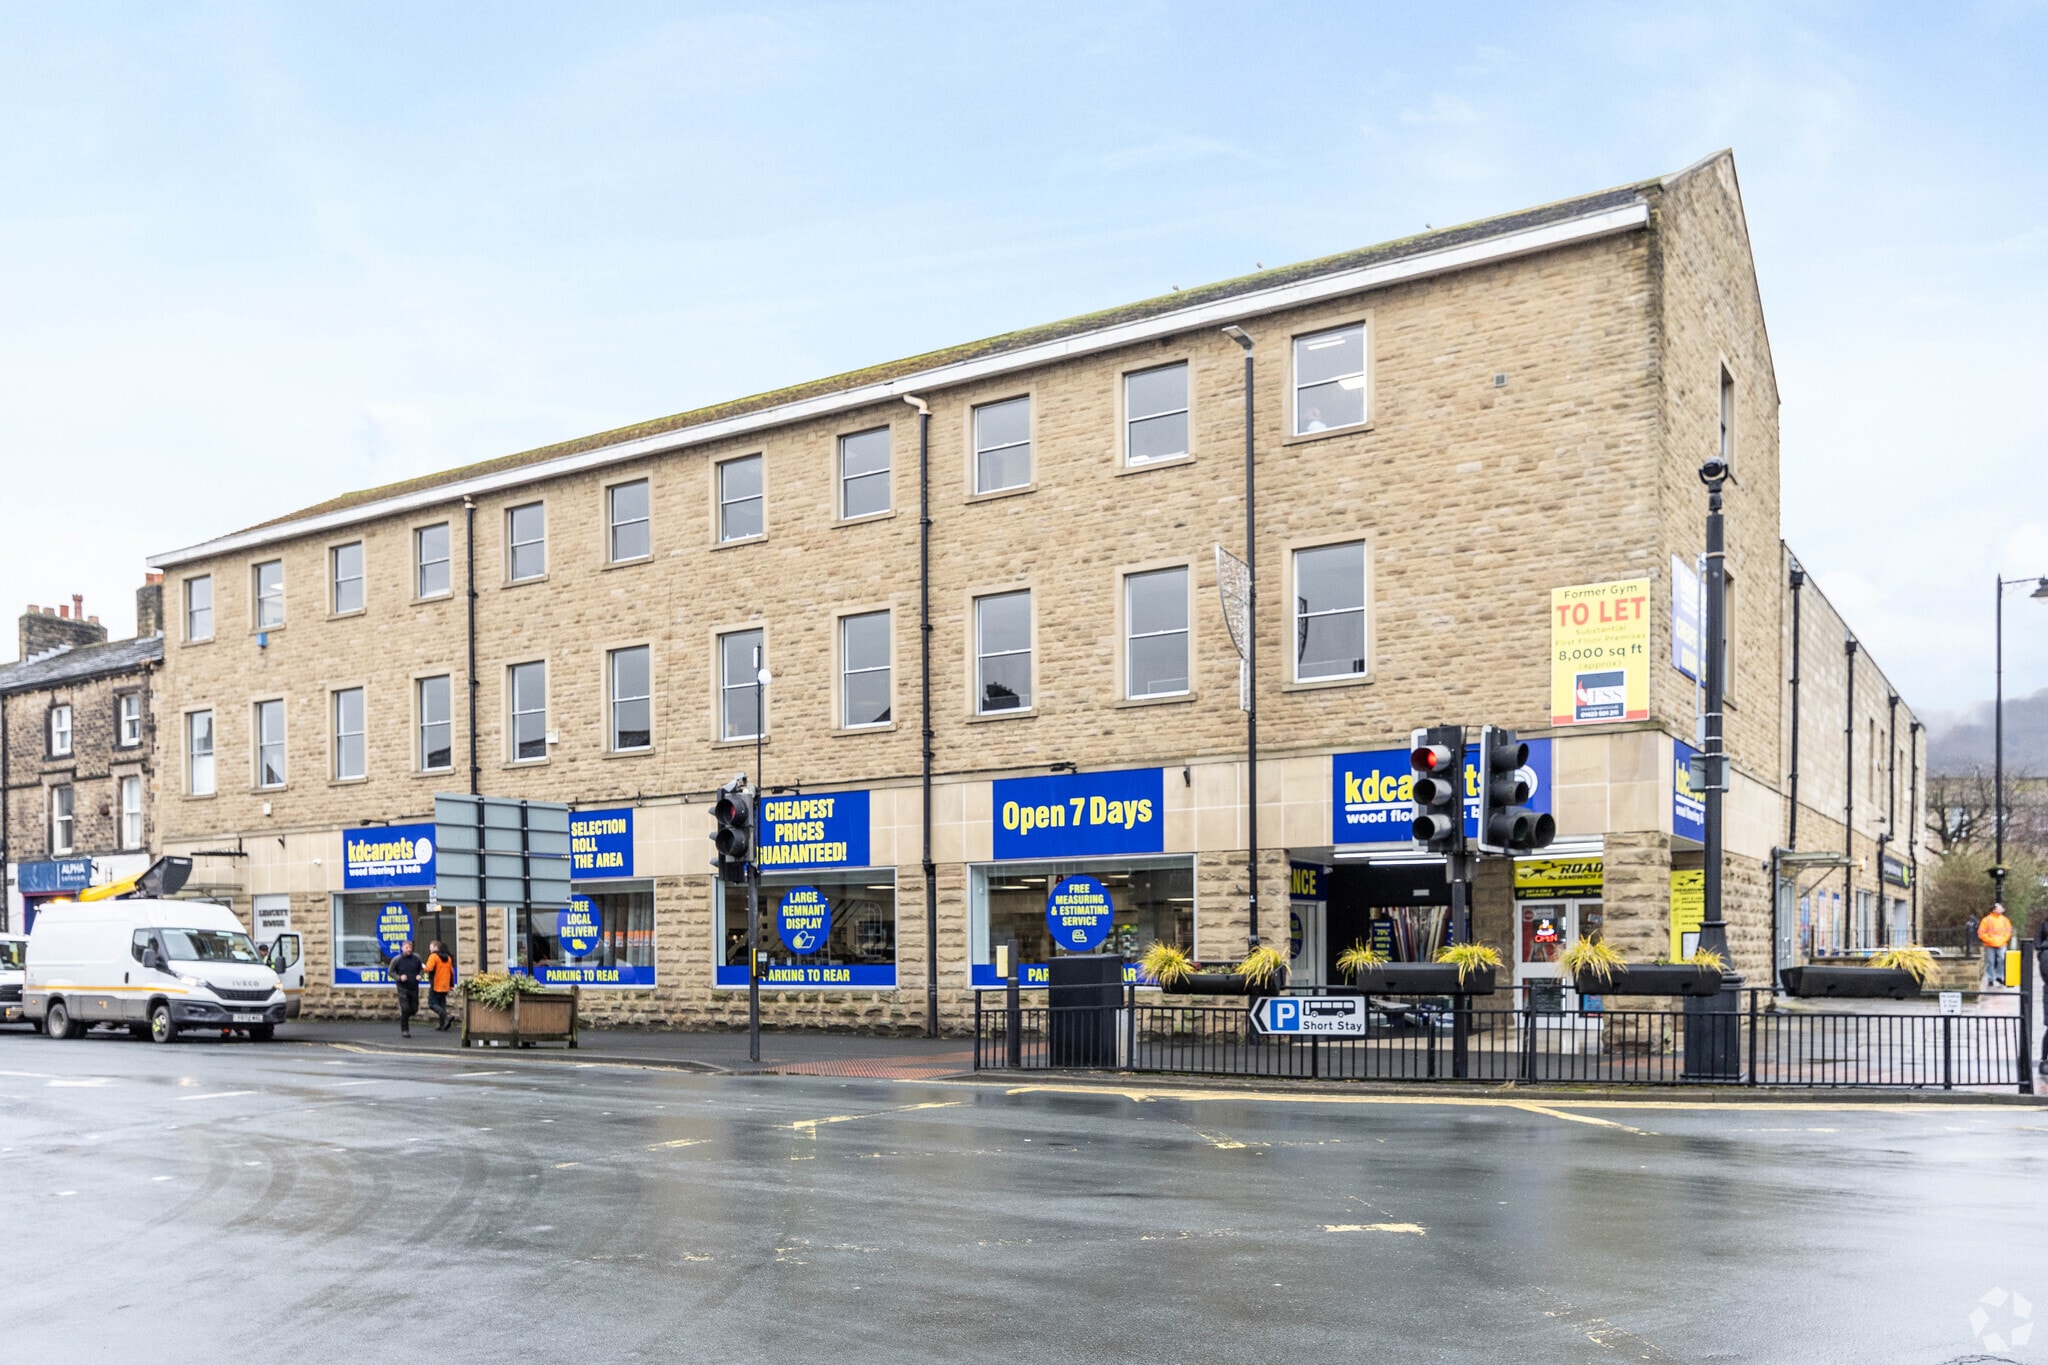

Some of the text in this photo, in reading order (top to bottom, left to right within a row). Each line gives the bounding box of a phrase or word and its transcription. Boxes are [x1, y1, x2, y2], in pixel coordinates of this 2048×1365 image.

[1564, 584, 1637, 600] Former Gym
[1556, 596, 1646, 627] TO LET
[1576, 625, 1626, 635] Substantial
[1559, 643, 1643, 661] 8,000 sq ft
[765, 799, 835, 822] CHEAPEST
[1002, 796, 1152, 835] Open 7 Days
[1346, 809, 1413, 824] wood flo
[571, 818, 626, 837] SELECTION
[775, 821, 825, 843] PRICES
[348, 837, 414, 866] kdcarpets
[572, 837, 598, 853] ROLL
[574, 852, 624, 869] THE AREA
[61, 863, 85, 875] ALPHA
[349, 867, 368, 877] wood
[369, 865, 395, 877] flooring
[403, 864, 421, 874] beds
[1069, 884, 1090, 894] FREE
[789, 891, 818, 904] LARGE
[1055, 894, 1104, 905] MEASURING
[386, 906, 396, 915] BED
[782, 904, 826, 917] REMNANT
[1051, 905, 1109, 916] & ESTIMATING
[381, 915, 408, 924] MATTRESS
[567, 913, 592, 925] LOCAL
[785, 917, 822, 930] DISPLAY
[1062, 916, 1098, 927] SERVICE
[380, 924, 410, 933] SHOWROOM
[561, 925, 599, 938] DELIVERY
[383, 932, 408, 942] UPSTAIRS
[1534, 934, 1559, 943] OPEN
[361, 970, 379, 982] OPEN
[381, 971, 386, 982] 7
[547, 970, 619, 982] PARKING TO REAR
[762, 969, 851, 982] ARKING TO REAR
[1277, 1003, 1295, 1029] P
[1303, 1020, 1362, 1032] Short Stay
